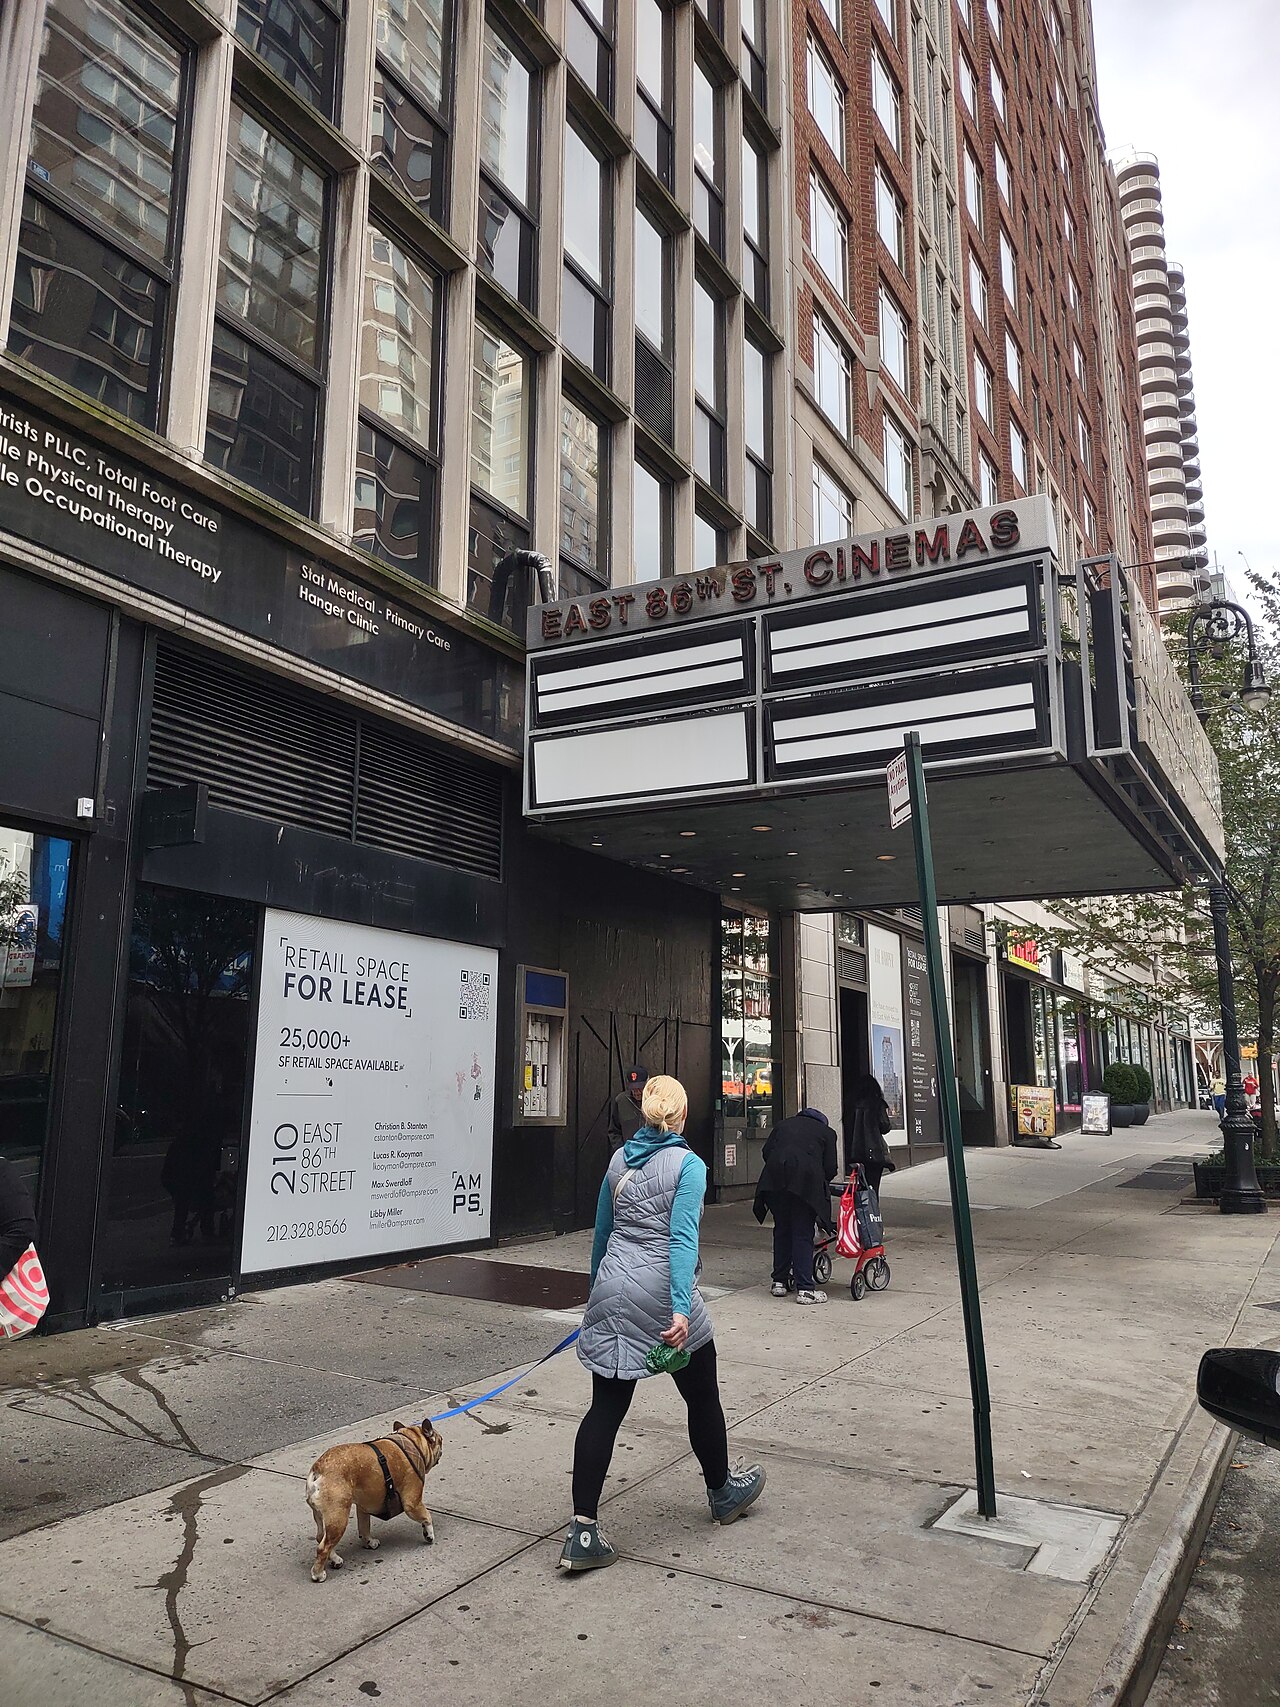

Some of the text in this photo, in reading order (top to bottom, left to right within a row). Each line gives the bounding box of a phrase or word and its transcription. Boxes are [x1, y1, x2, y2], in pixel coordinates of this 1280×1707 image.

[27, 450, 103, 501] Physical
[107, 489, 174, 537] Therapy
[45, 431, 91, 471] PLLC,
[97, 458, 138, 492] Total
[142, 481, 177, 512] Foot
[181, 503, 218, 533] Care
[25, 477, 153, 550] Occupational
[158, 538, 222, 583] Therapy
[541, 509, 1021, 641] EAST 86th ST. CINEMAS
[299, 585, 380, 635] Hanger Clinic
[301, 564, 325, 588] Stat
[327, 578, 375, 614] Medical
[386, 608, 424, 639] Primary
[426, 630, 451, 651] Care
[888, 768, 895, 782] NO
[285, 946, 409, 982] RETAIL SPACE
[283, 972, 408, 1010] FOR LEASE
[279, 1027, 351, 1051] 25,000+
[278, 1055, 399, 1071] SF RETAIL SPACE AVAILABLE
[303, 1122, 343, 1144] EAST
[374, 1122, 400, 1130] Christian
[407, 1121, 428, 1130] Stanton
[271, 1123, 299, 1195] 210
[301, 1146, 337, 1169] 86TH
[373, 1151, 389, 1160] Lucas
[299, 1170, 356, 1194] STREET
[371, 1180, 384, 1189] Max
[369, 1207, 403, 1219] Libby Miller
[267, 1218, 347, 1242] 212.328.8566
